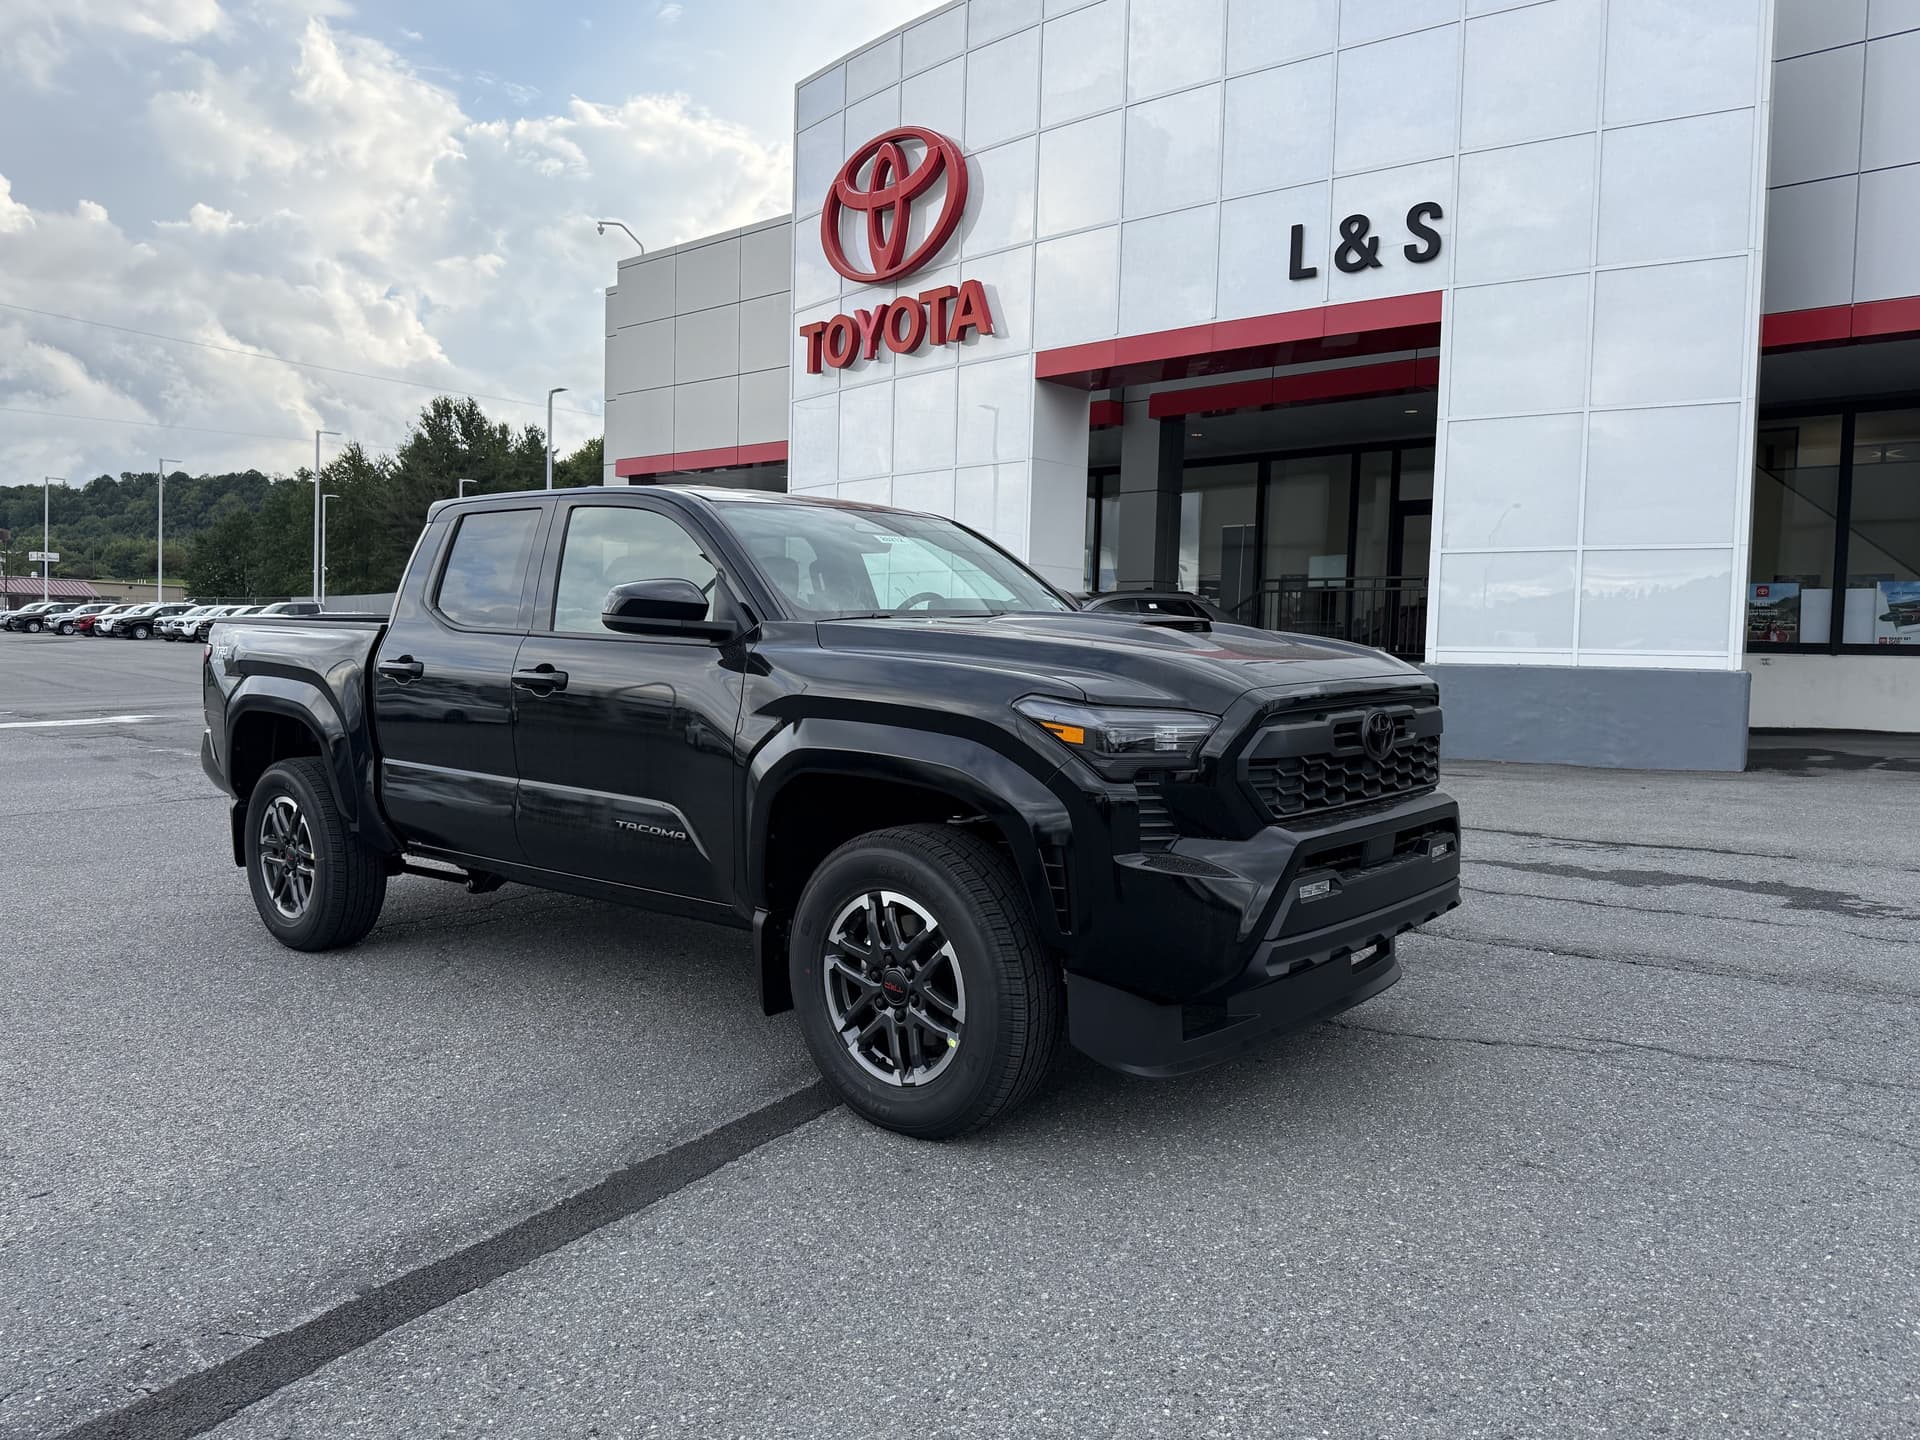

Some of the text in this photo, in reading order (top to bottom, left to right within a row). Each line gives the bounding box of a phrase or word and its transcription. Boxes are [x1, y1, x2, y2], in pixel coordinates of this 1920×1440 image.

[1289, 201, 1444, 281] L & S
[799, 279, 994, 375] TOYOTA
[615, 820, 687, 840] TACOMA
